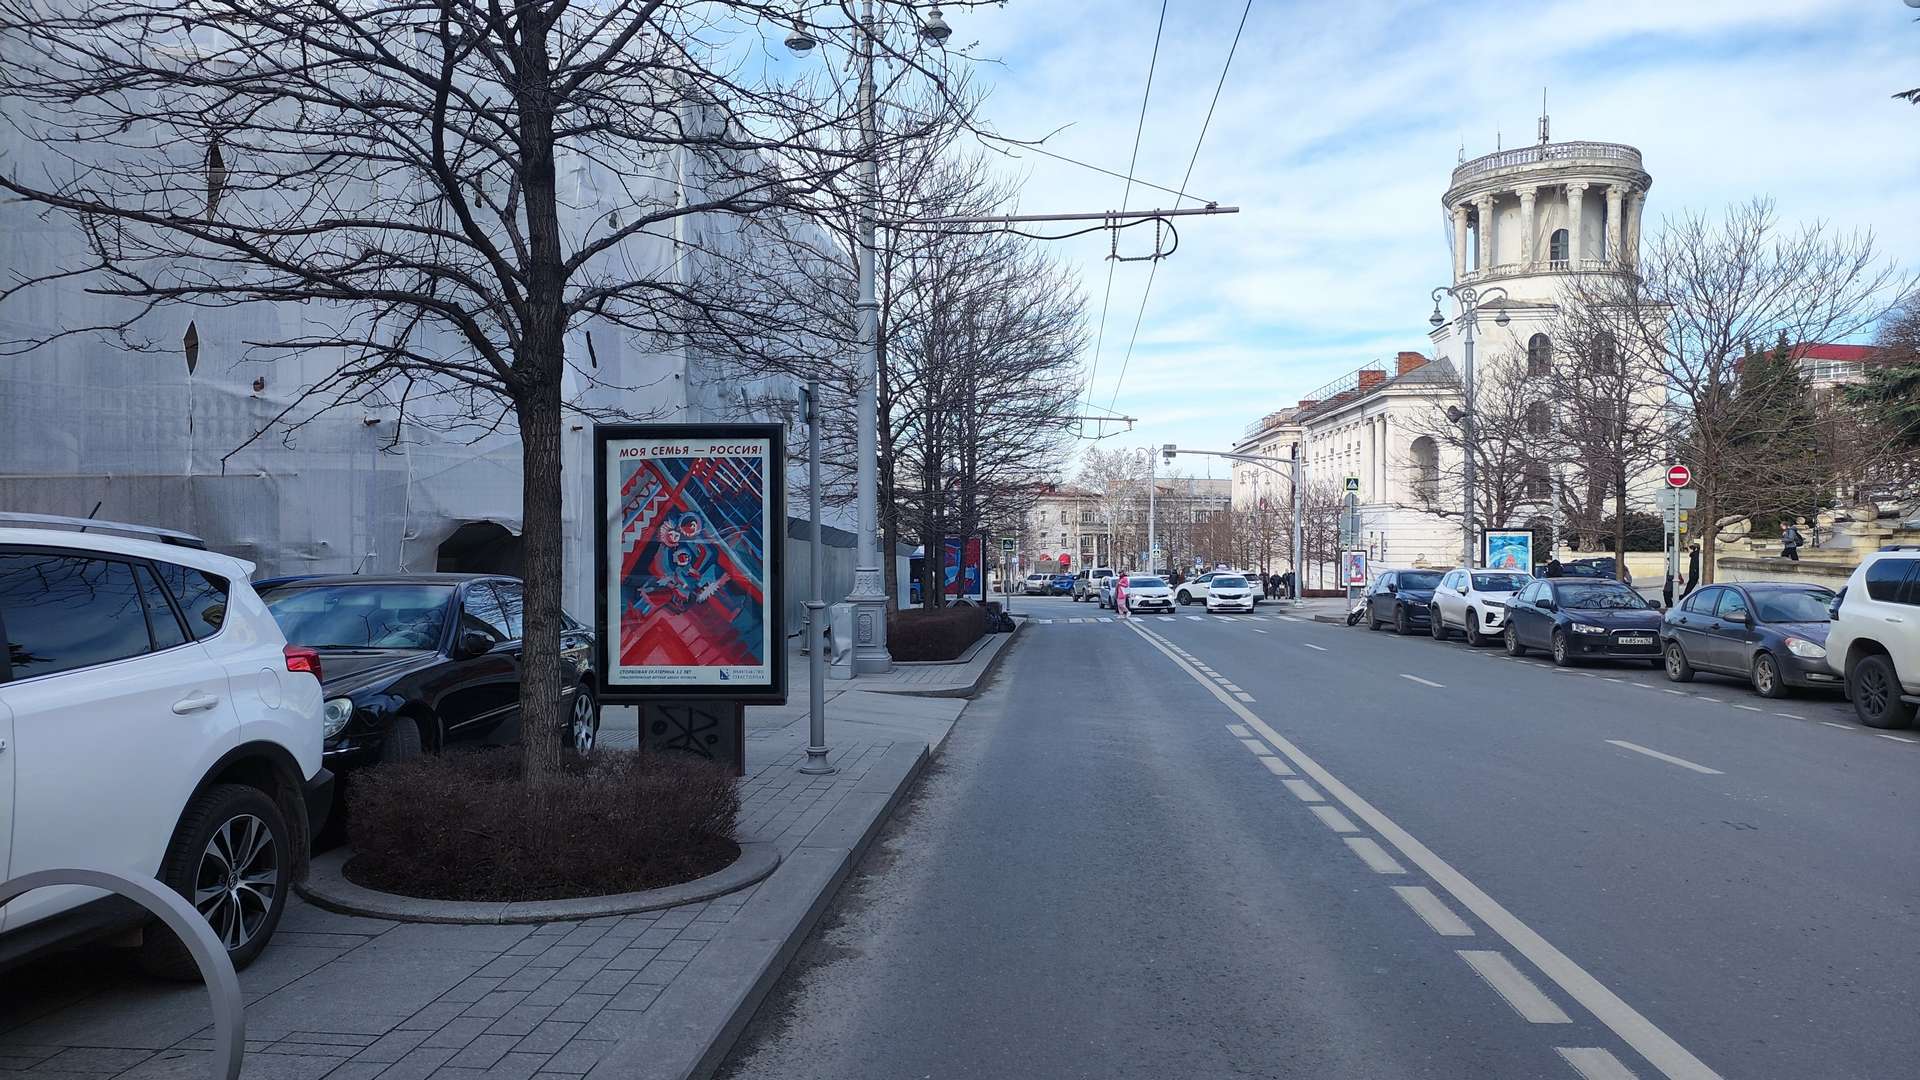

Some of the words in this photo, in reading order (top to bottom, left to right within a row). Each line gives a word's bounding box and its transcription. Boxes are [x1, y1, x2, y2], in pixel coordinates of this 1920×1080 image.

[619, 447, 646, 458] МОЯ
[651, 446, 689, 456] СЕМЬЯ
[709, 445, 762, 455] РОССИЯ!
